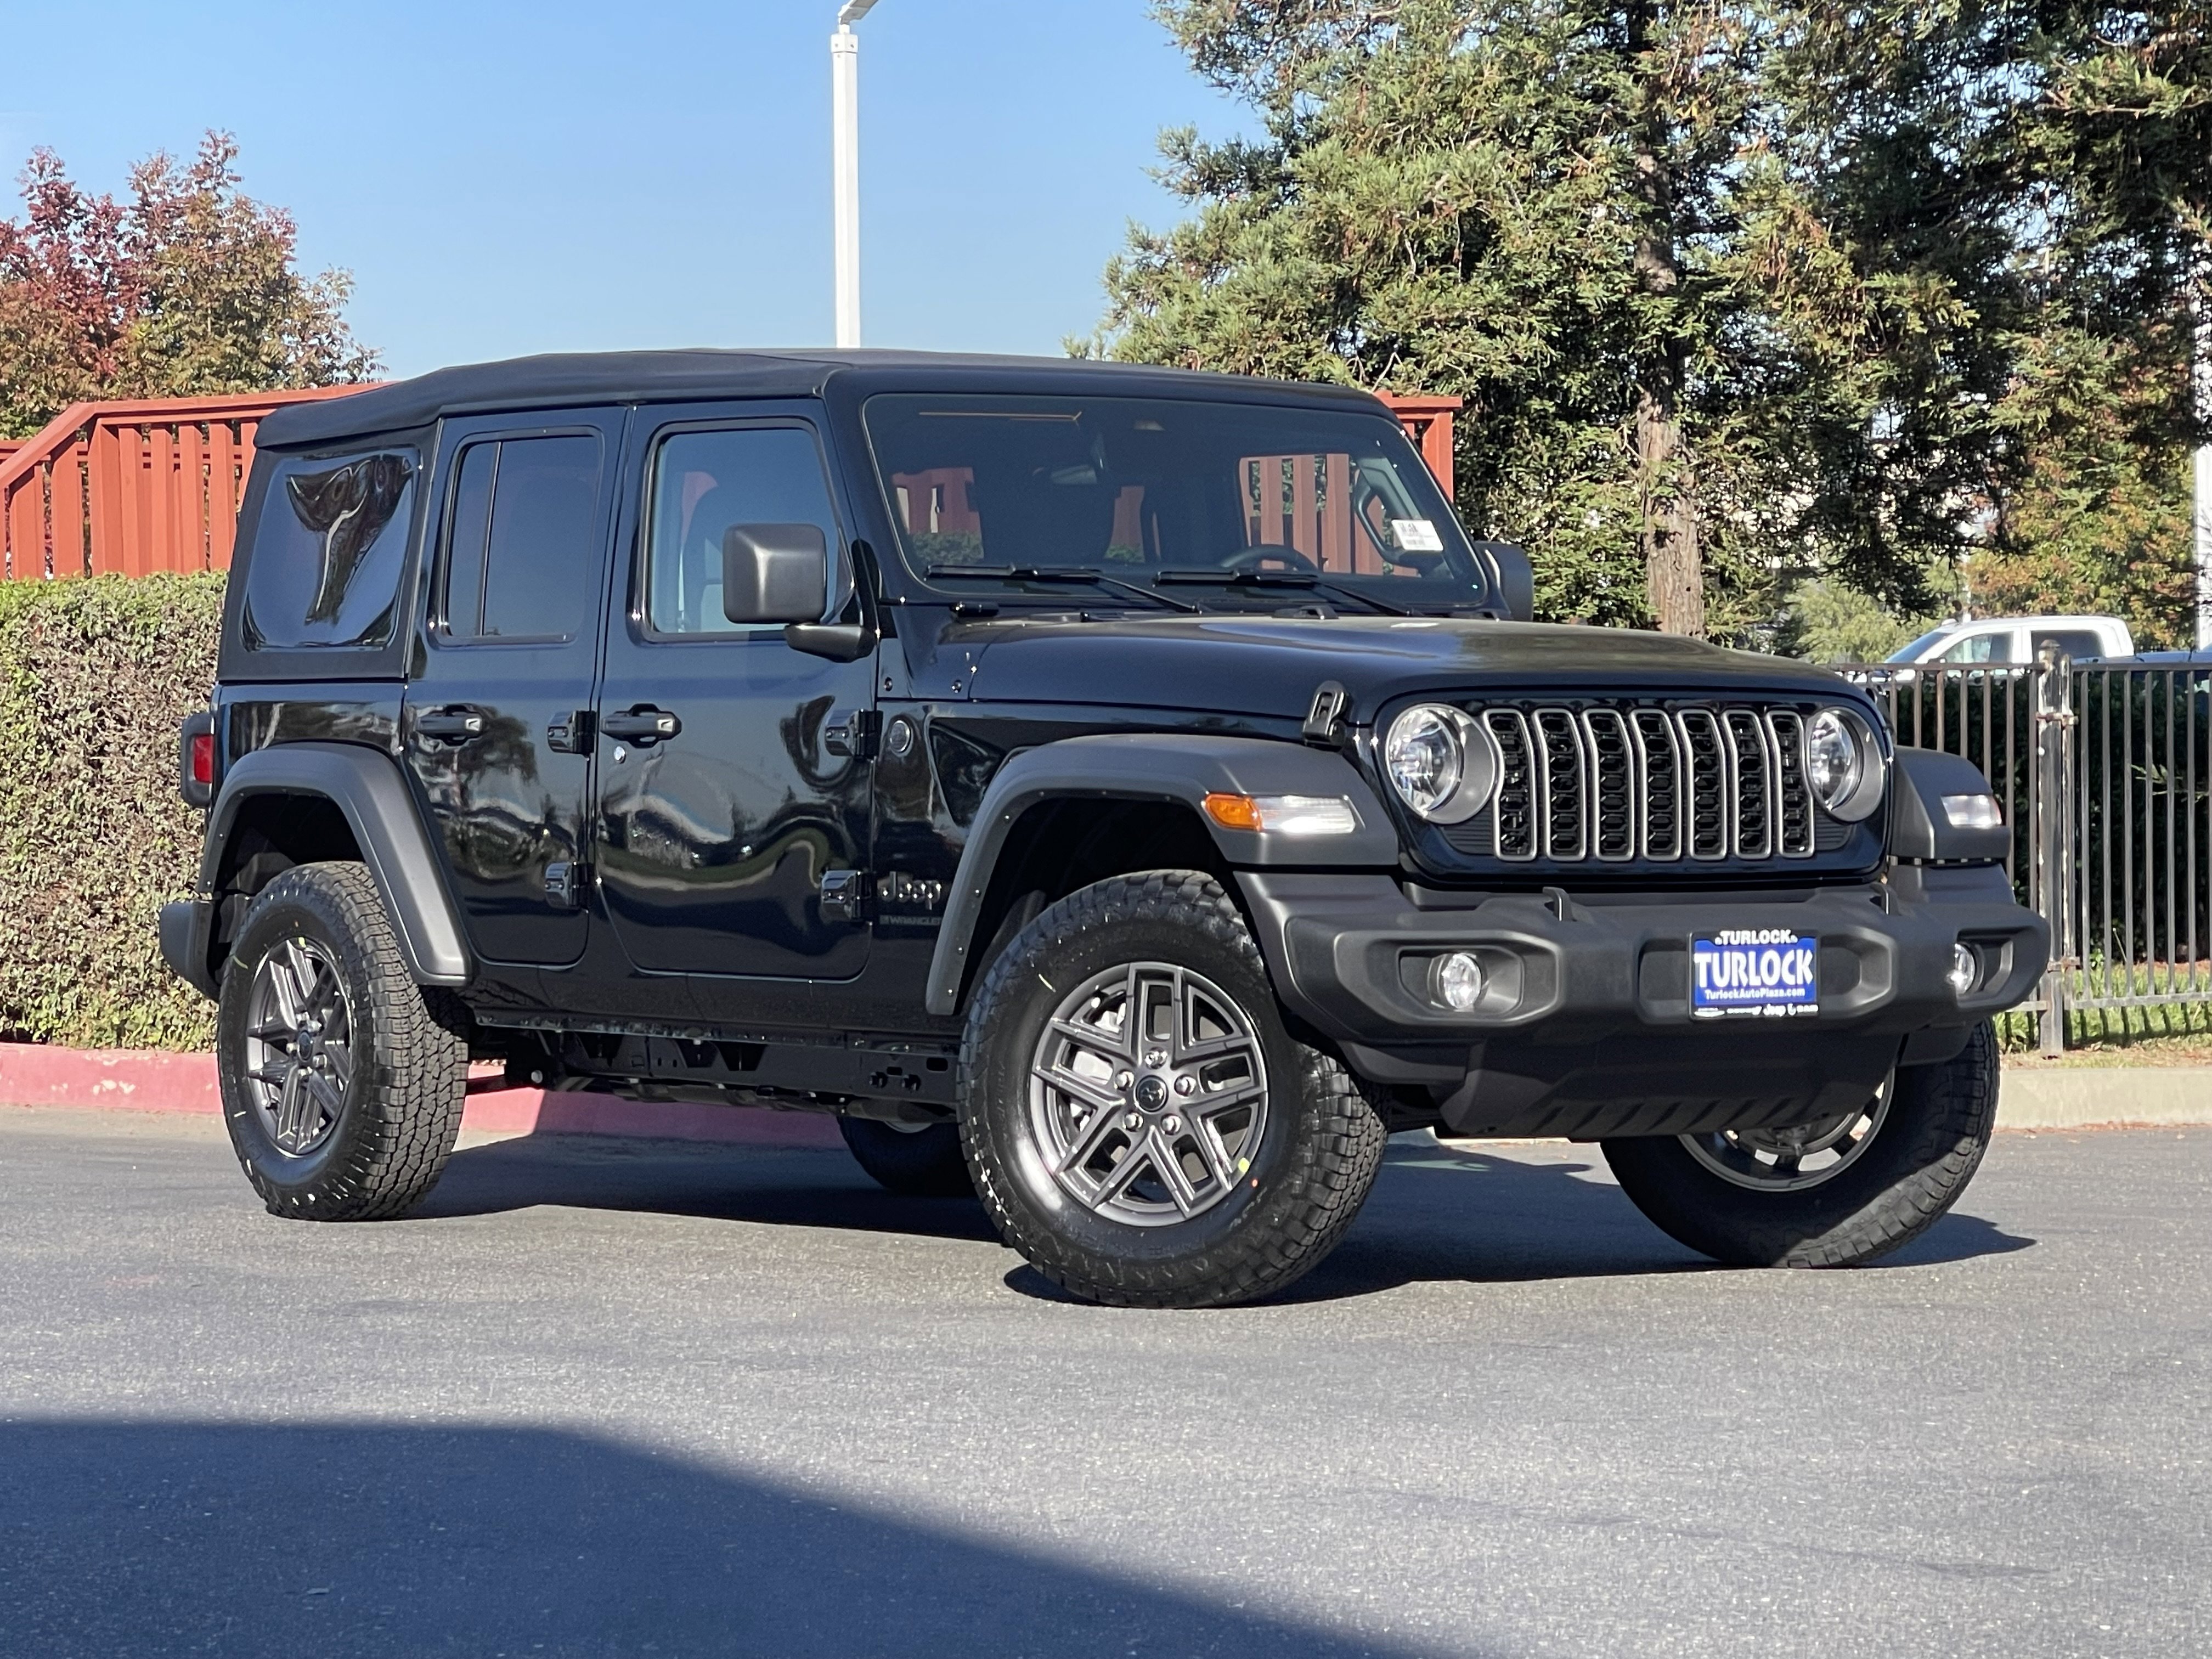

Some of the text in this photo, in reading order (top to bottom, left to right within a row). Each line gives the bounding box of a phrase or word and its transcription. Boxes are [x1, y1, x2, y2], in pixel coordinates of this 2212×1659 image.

[881, 871, 941, 911] Jeep
[889, 915, 943, 926] WRANGLE
[1719, 929, 1791, 945] TURLOCK
[1694, 949, 1813, 988] TURLOCK
[1705, 988, 1805, 1000] TurlockAutoPlaza.com
